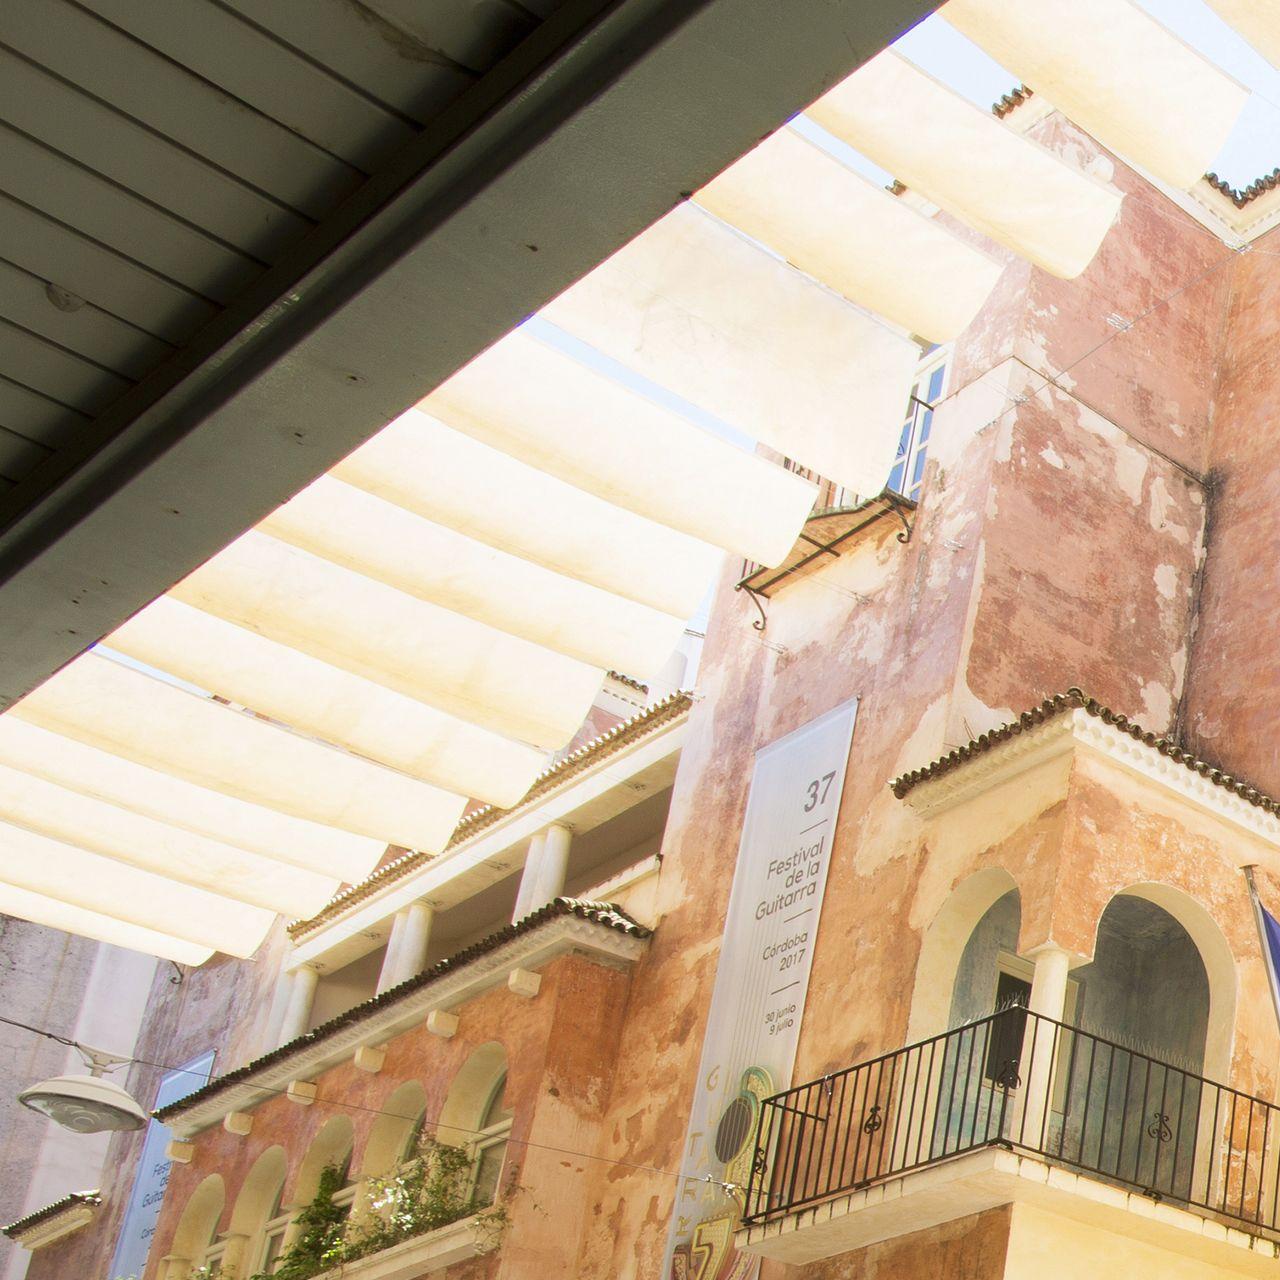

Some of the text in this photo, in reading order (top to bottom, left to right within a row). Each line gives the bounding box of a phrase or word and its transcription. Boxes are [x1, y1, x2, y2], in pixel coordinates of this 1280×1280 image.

[804, 770, 836, 812] 37
[767, 836, 824, 880] Festival
[785, 861, 820, 888] de la
[755, 881, 816, 920] Guitarra
[762, 932, 808, 960] Córdoba
[779, 949, 806, 971] 2017
[775, 1004, 796, 1023] junio
